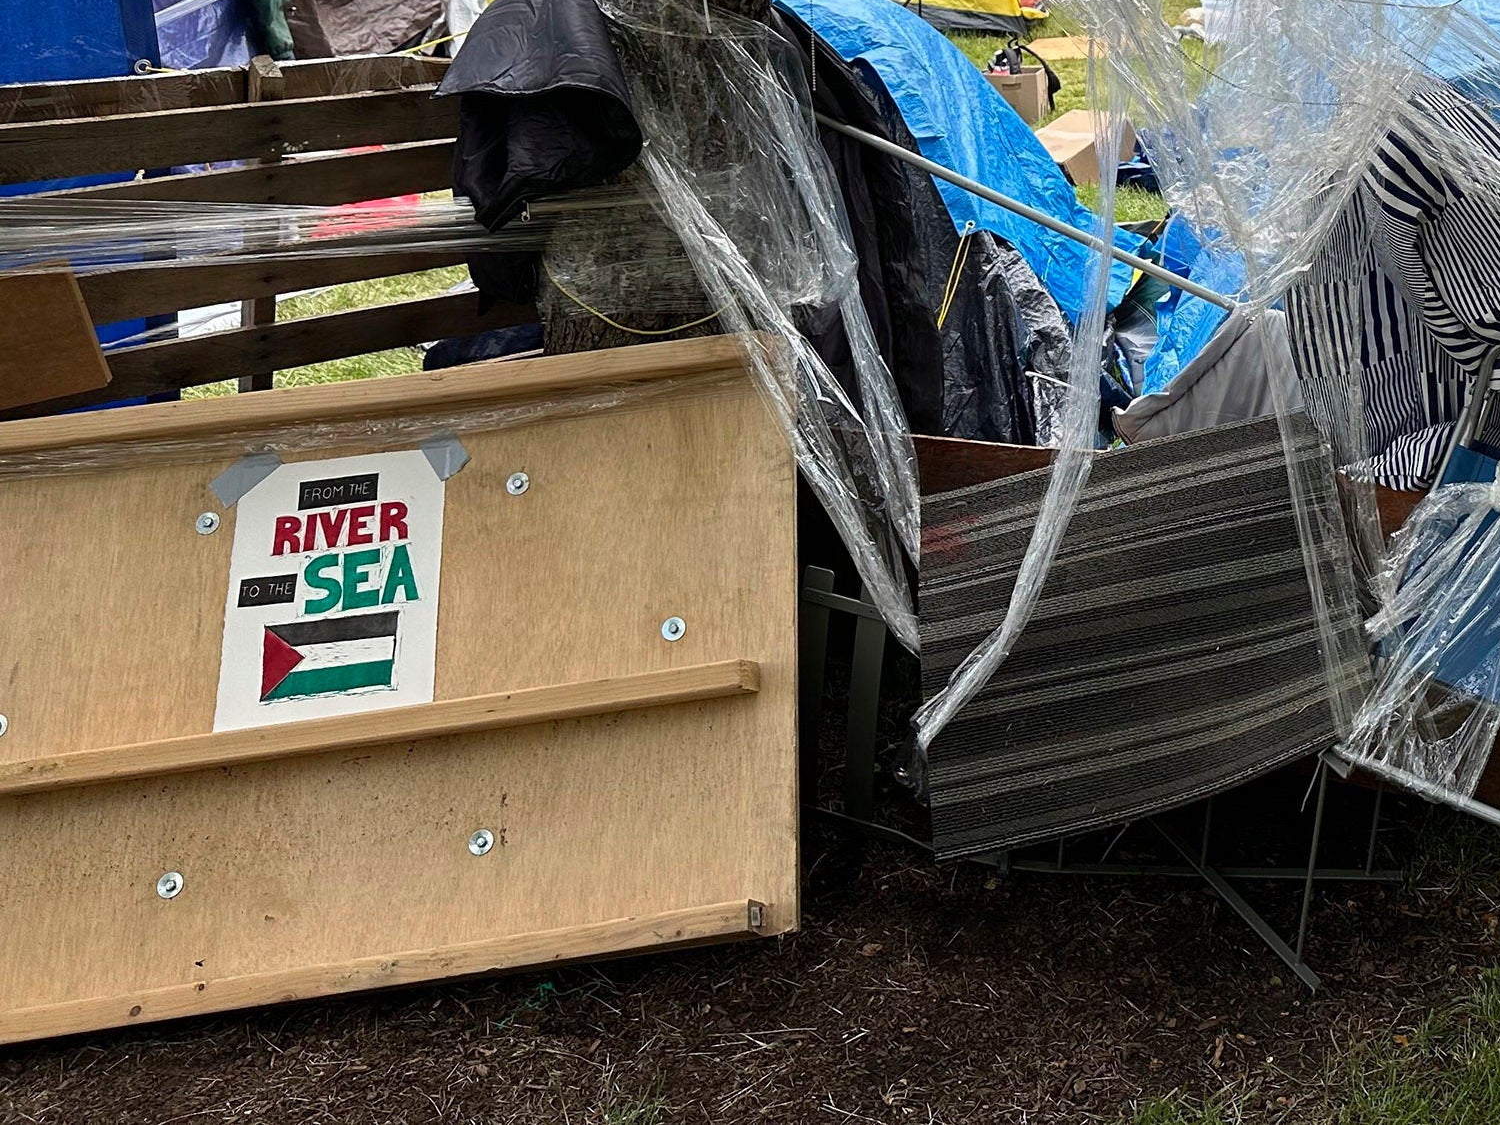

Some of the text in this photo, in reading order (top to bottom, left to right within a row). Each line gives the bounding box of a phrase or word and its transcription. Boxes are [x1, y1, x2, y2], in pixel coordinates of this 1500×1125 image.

[303, 481, 371, 502] FROM THE
[270, 501, 409, 557] RIVER
[241, 544, 420, 615] TO THE SEA
